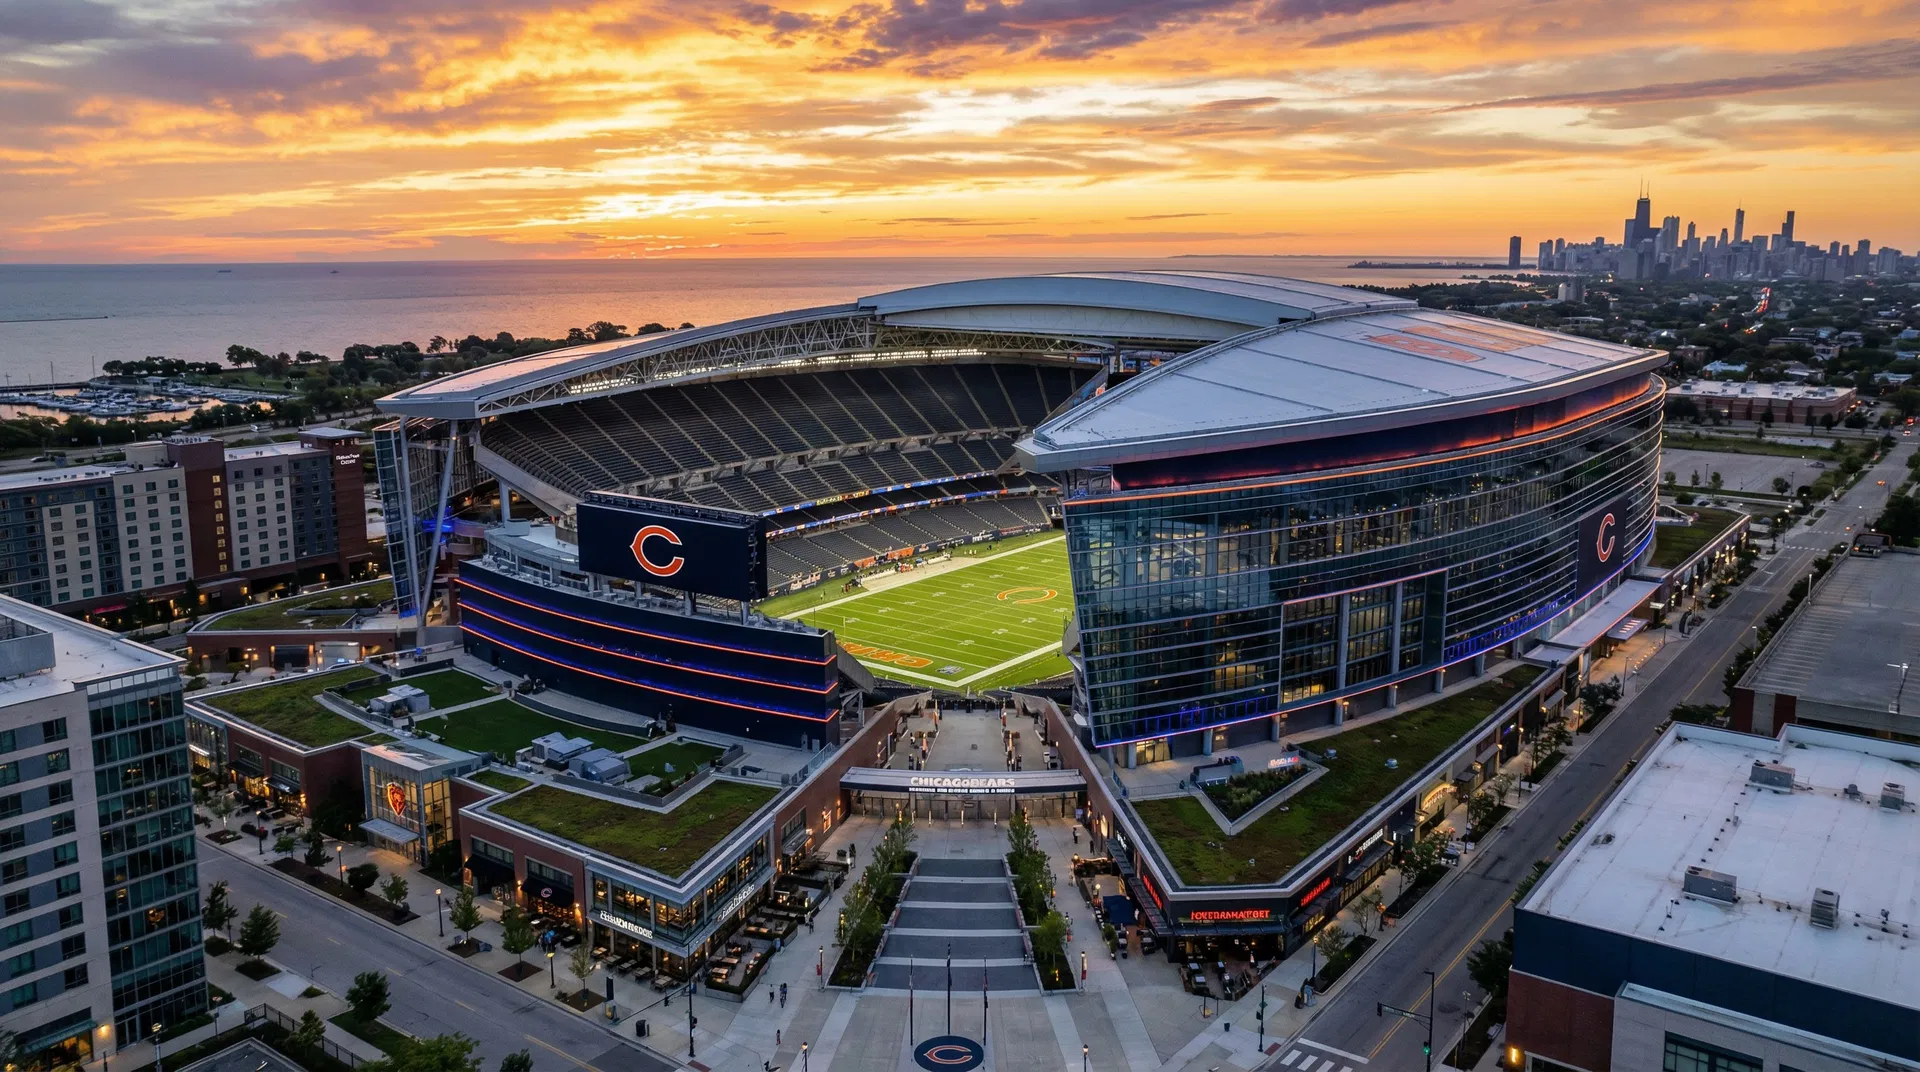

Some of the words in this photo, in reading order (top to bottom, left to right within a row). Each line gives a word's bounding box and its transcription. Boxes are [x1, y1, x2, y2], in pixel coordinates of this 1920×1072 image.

[630, 525, 684, 576] C
[1596, 513, 1615, 562] C
[923, 1045, 973, 1065] C
